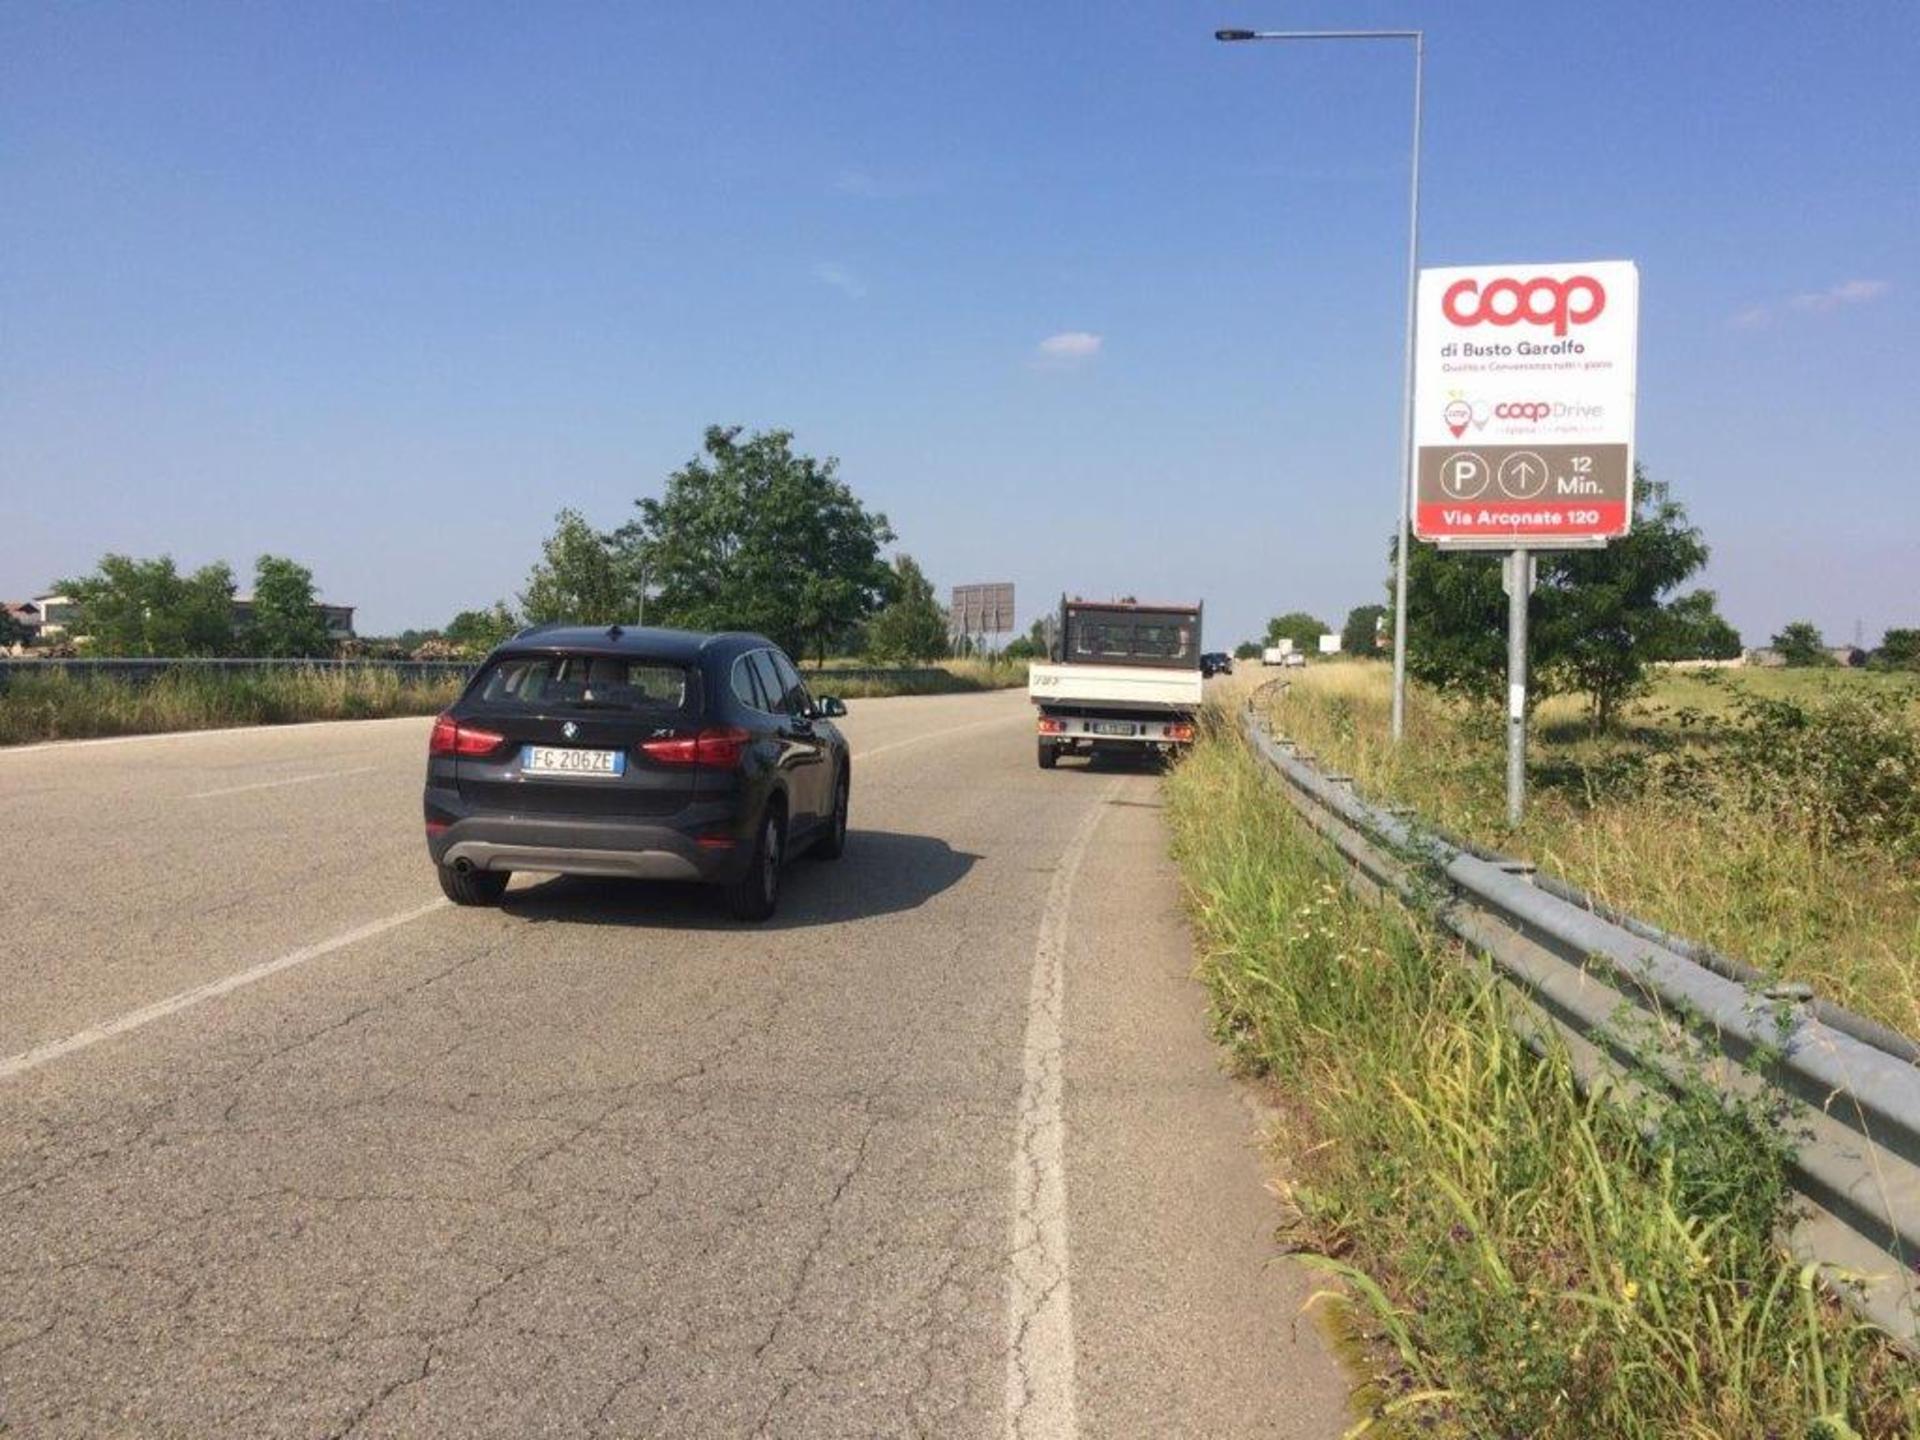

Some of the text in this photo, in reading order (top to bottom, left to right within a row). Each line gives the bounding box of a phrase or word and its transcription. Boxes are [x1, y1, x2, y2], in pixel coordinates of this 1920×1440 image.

[1442, 275, 1606, 336] coop
[1441, 340, 1585, 357] di Busto Garolfo
[1570, 457, 1592, 472] 12
[1455, 462, 1477, 491] P
[1557, 477, 1604, 494] Min.
[1443, 510, 1599, 526] Via Arconate 120
